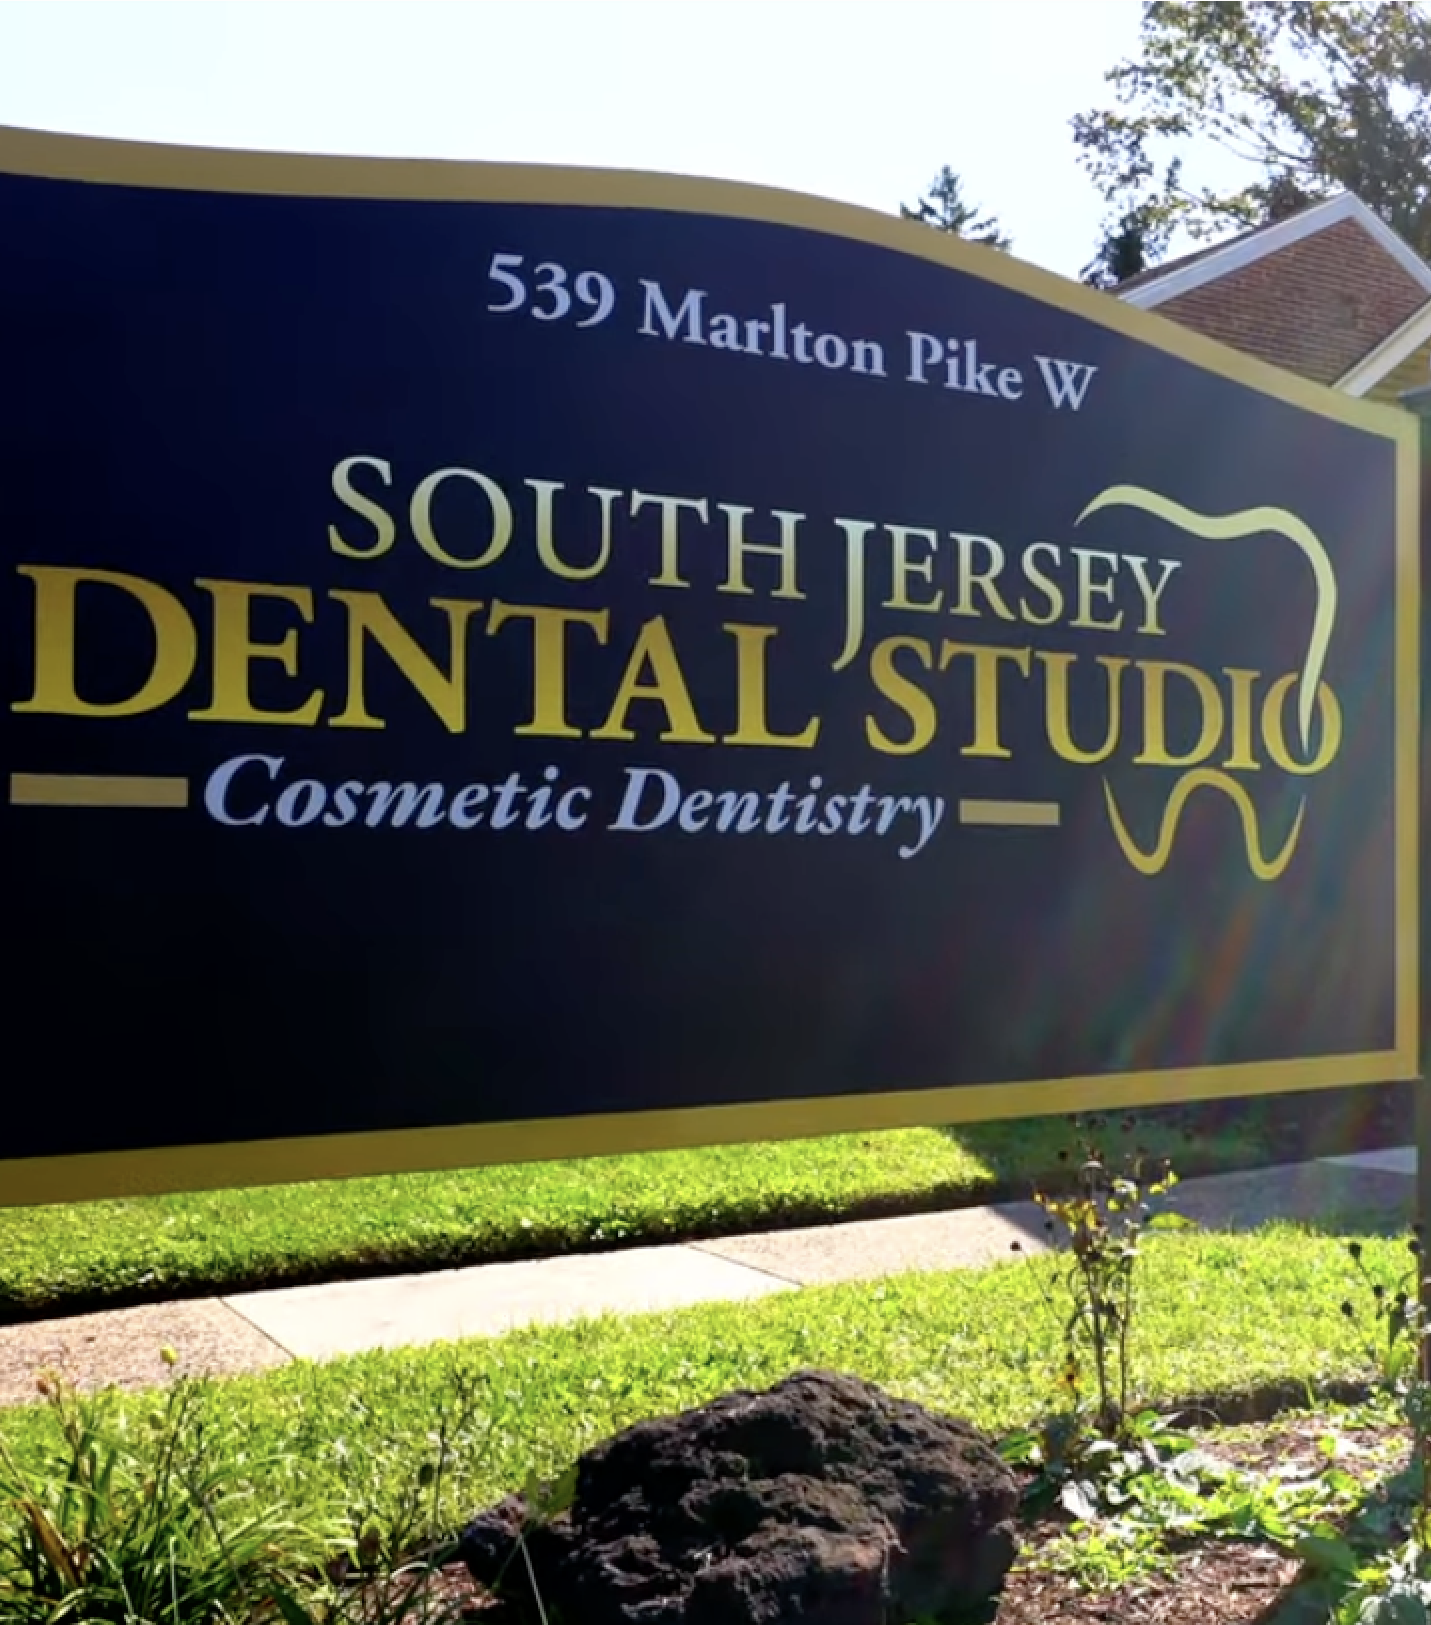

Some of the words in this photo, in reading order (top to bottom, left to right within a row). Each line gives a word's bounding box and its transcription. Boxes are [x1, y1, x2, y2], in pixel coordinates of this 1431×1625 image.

[486, 252, 616, 328] 539
[637, 278, 887, 378] Marlton
[904, 330, 1025, 402] Pike
[1033, 354, 1099, 412] W
[328, 456, 808, 600] SOUTH
[832, 516, 1183, 670] JERSEY
[10, 564, 820, 748] DENTAL
[865, 636, 1343, 776] STUDIO
[204, 753, 592, 830] Cosmetic
[608, 767, 945, 860] Dentistry
